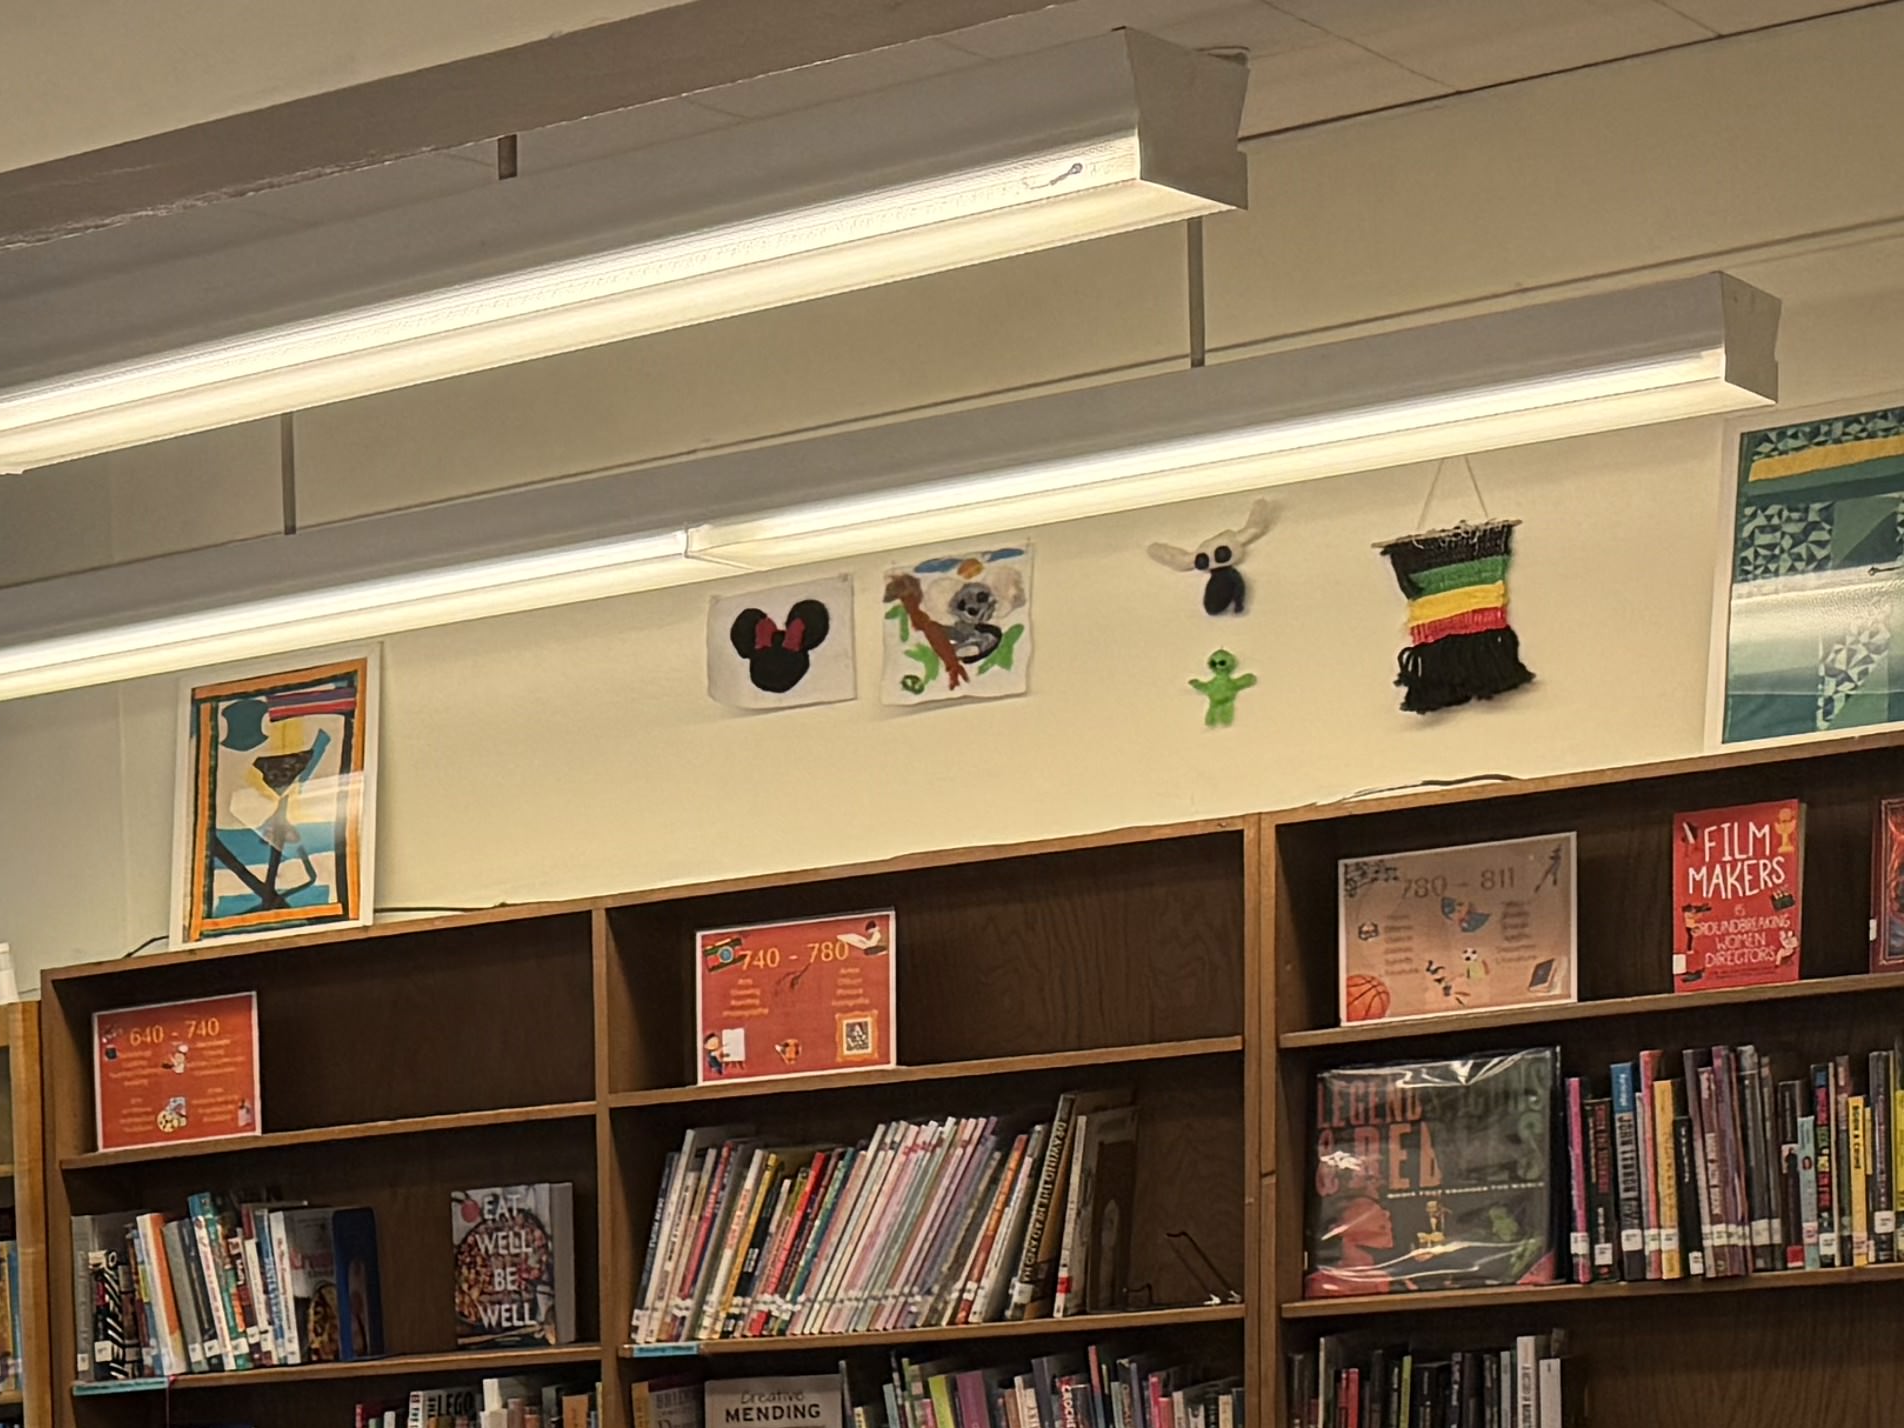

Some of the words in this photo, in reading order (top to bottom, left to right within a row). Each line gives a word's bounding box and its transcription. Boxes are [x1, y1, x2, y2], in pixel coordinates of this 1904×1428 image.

[1703, 821, 1771, 863] FILM
[1401, 876, 1448, 900] 780
[1481, 867, 1515, 890] 811
[1688, 856, 1786, 900] MAKERS
[1692, 914, 1791, 936] GROUNDBREAKING
[1716, 932, 1767, 950] WOMEN
[742, 948, 780, 970] 740
[807, 942, 850, 964] 780
[1705, 949, 1776, 968] DIRECTORS
[130, 1025, 165, 1046] 640
[184, 1017, 220, 1039] 740
[1617, 1115, 1634, 1147] JOHN
[1042, 1120, 1067, 1182] DRAWING
[1619, 1149, 1638, 1198] LENNON
[1037, 1184, 1052, 1204] THE
[483, 1194, 520, 1221] EAT
[475, 1230, 533, 1255] WELL
[494, 1267, 518, 1292] BE
[477, 1302, 537, 1328] WELL
[739, 1389, 806, 1405] Creative
[724, 1403, 822, 1424] MENDING
